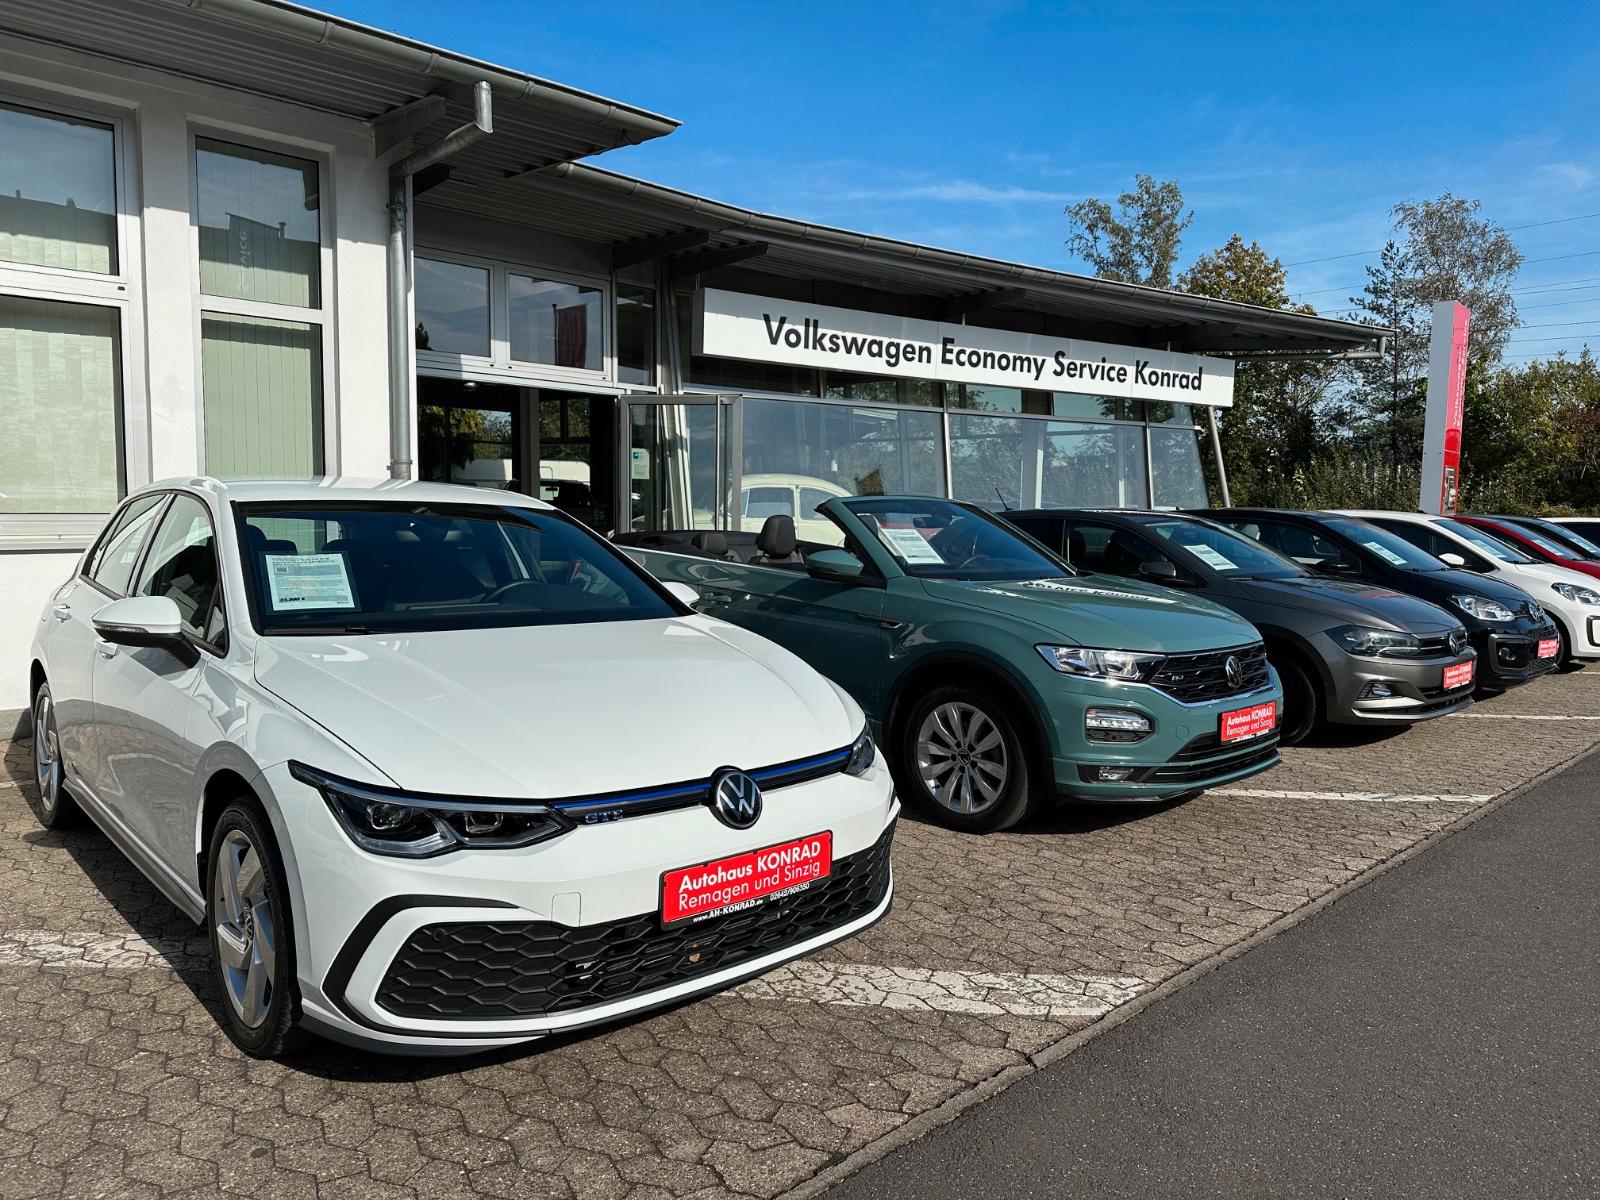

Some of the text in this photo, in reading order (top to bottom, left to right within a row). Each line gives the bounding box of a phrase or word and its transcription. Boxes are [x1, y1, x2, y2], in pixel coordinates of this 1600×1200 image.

[762, 312, 1203, 391] Volkswagen Economy Service Konrad
[679, 841, 821, 894] Autohaus KONRAD
[679, 860, 820, 911] Remagen und Sinzig
